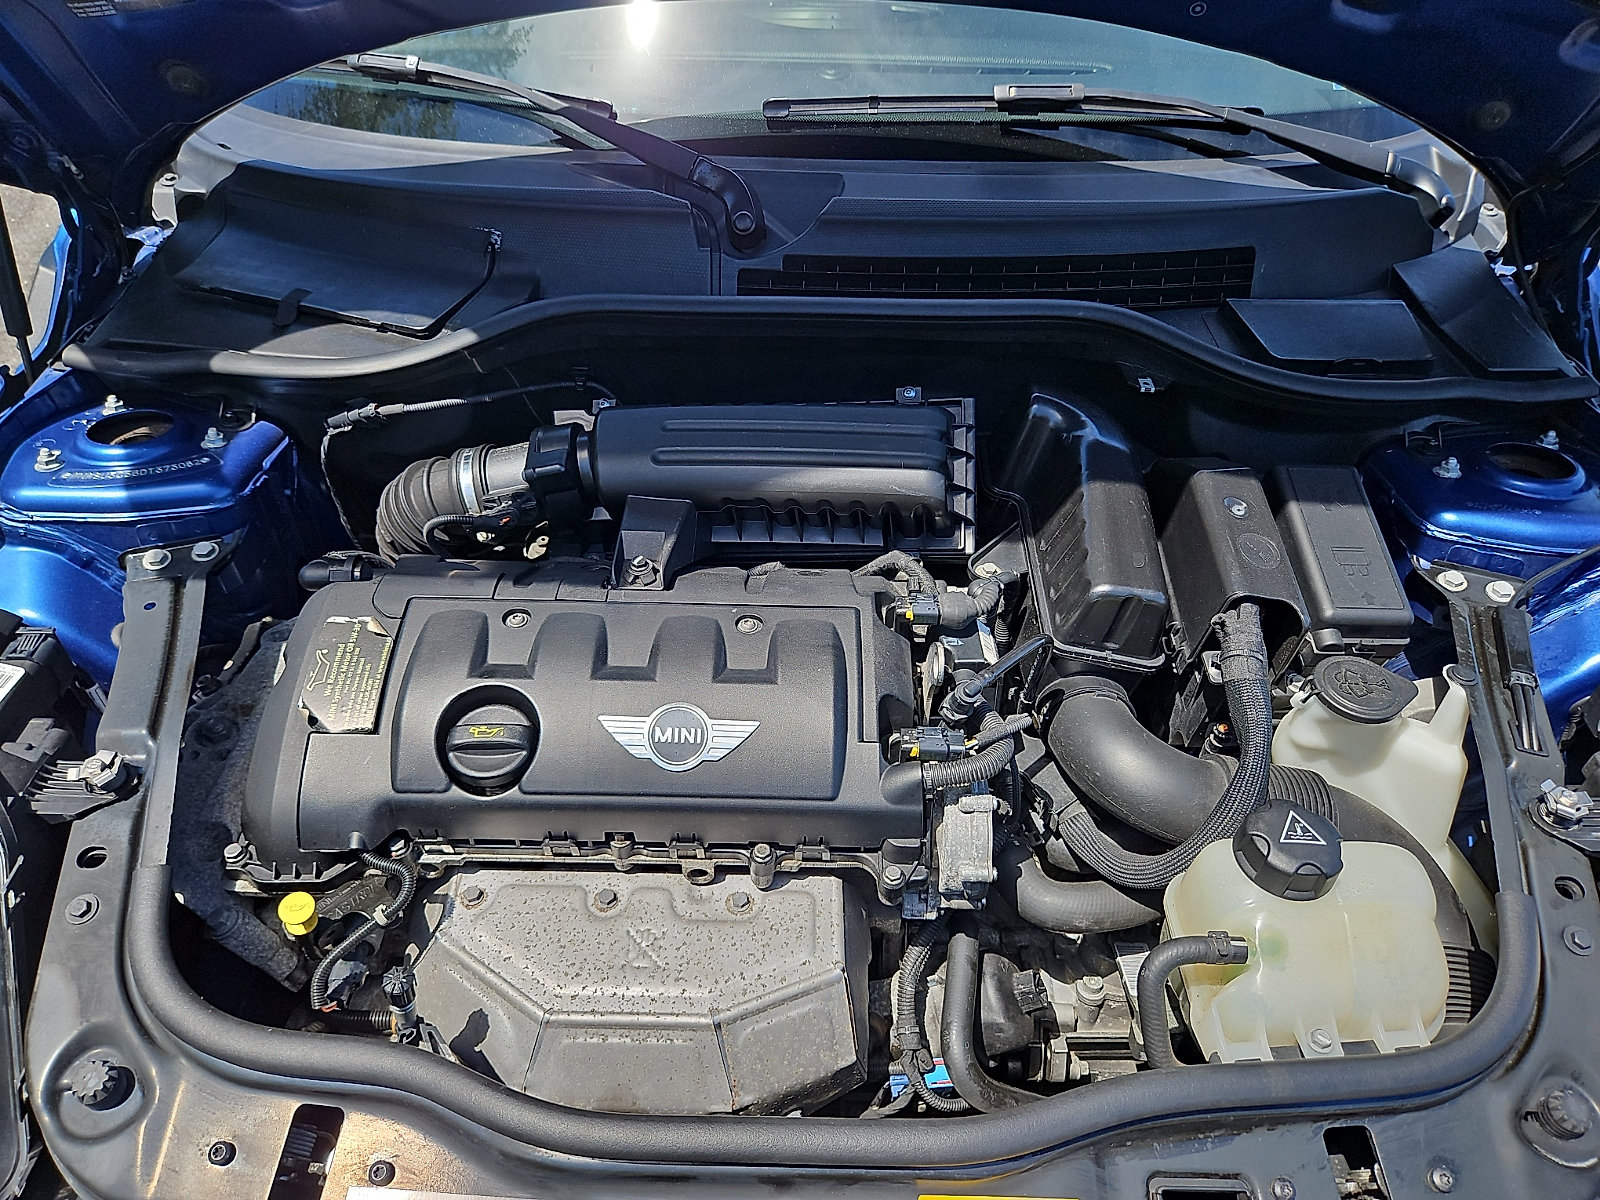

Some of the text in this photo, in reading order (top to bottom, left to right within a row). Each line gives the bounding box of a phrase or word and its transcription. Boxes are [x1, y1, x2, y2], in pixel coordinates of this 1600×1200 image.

[323, 643, 345, 696] We Recommend
[326, 623, 361, 720] MINI Synthetic Motor Oil 5W-30
[654, 727, 702, 745] MINI
